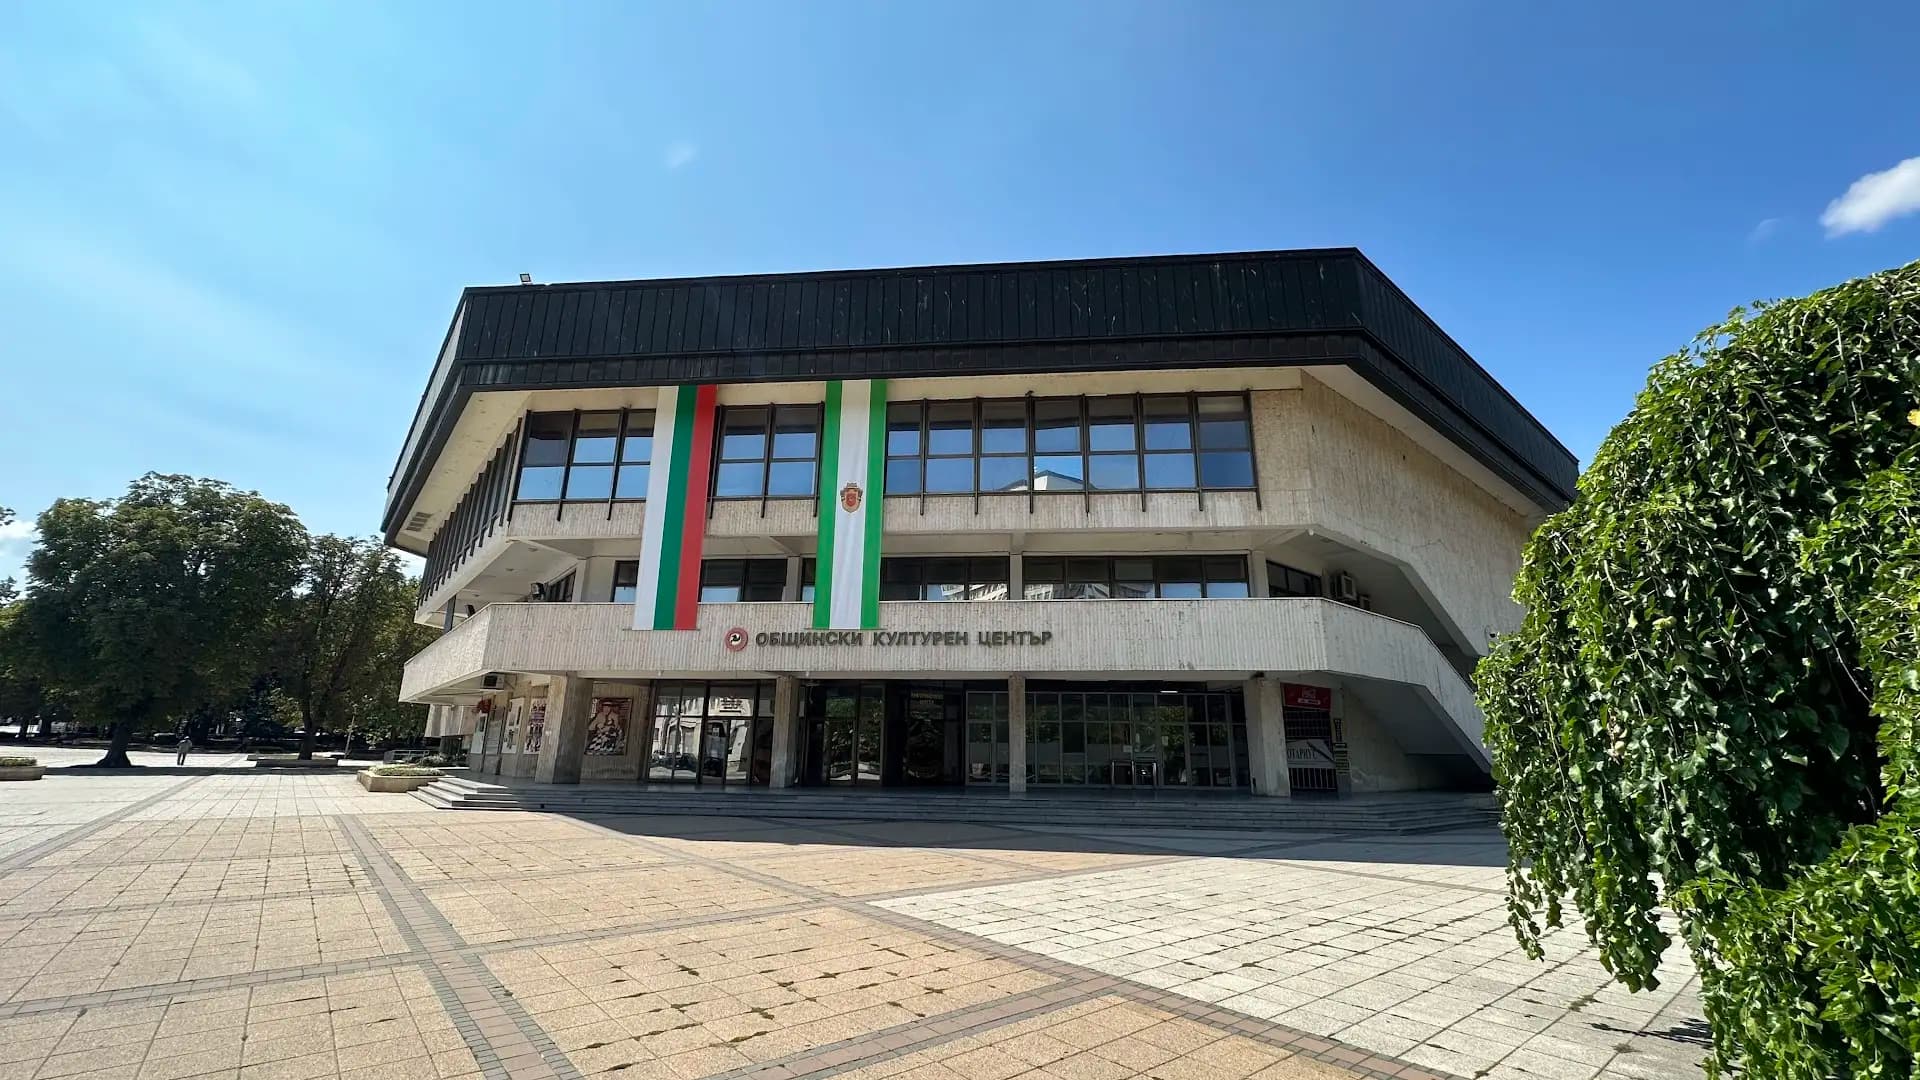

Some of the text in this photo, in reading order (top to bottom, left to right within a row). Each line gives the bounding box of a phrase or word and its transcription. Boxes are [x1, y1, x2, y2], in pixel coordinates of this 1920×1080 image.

[755, 631, 1053, 648] ОБЩИНСКИ КУЛТУРЕН ЦЕНТЪР
